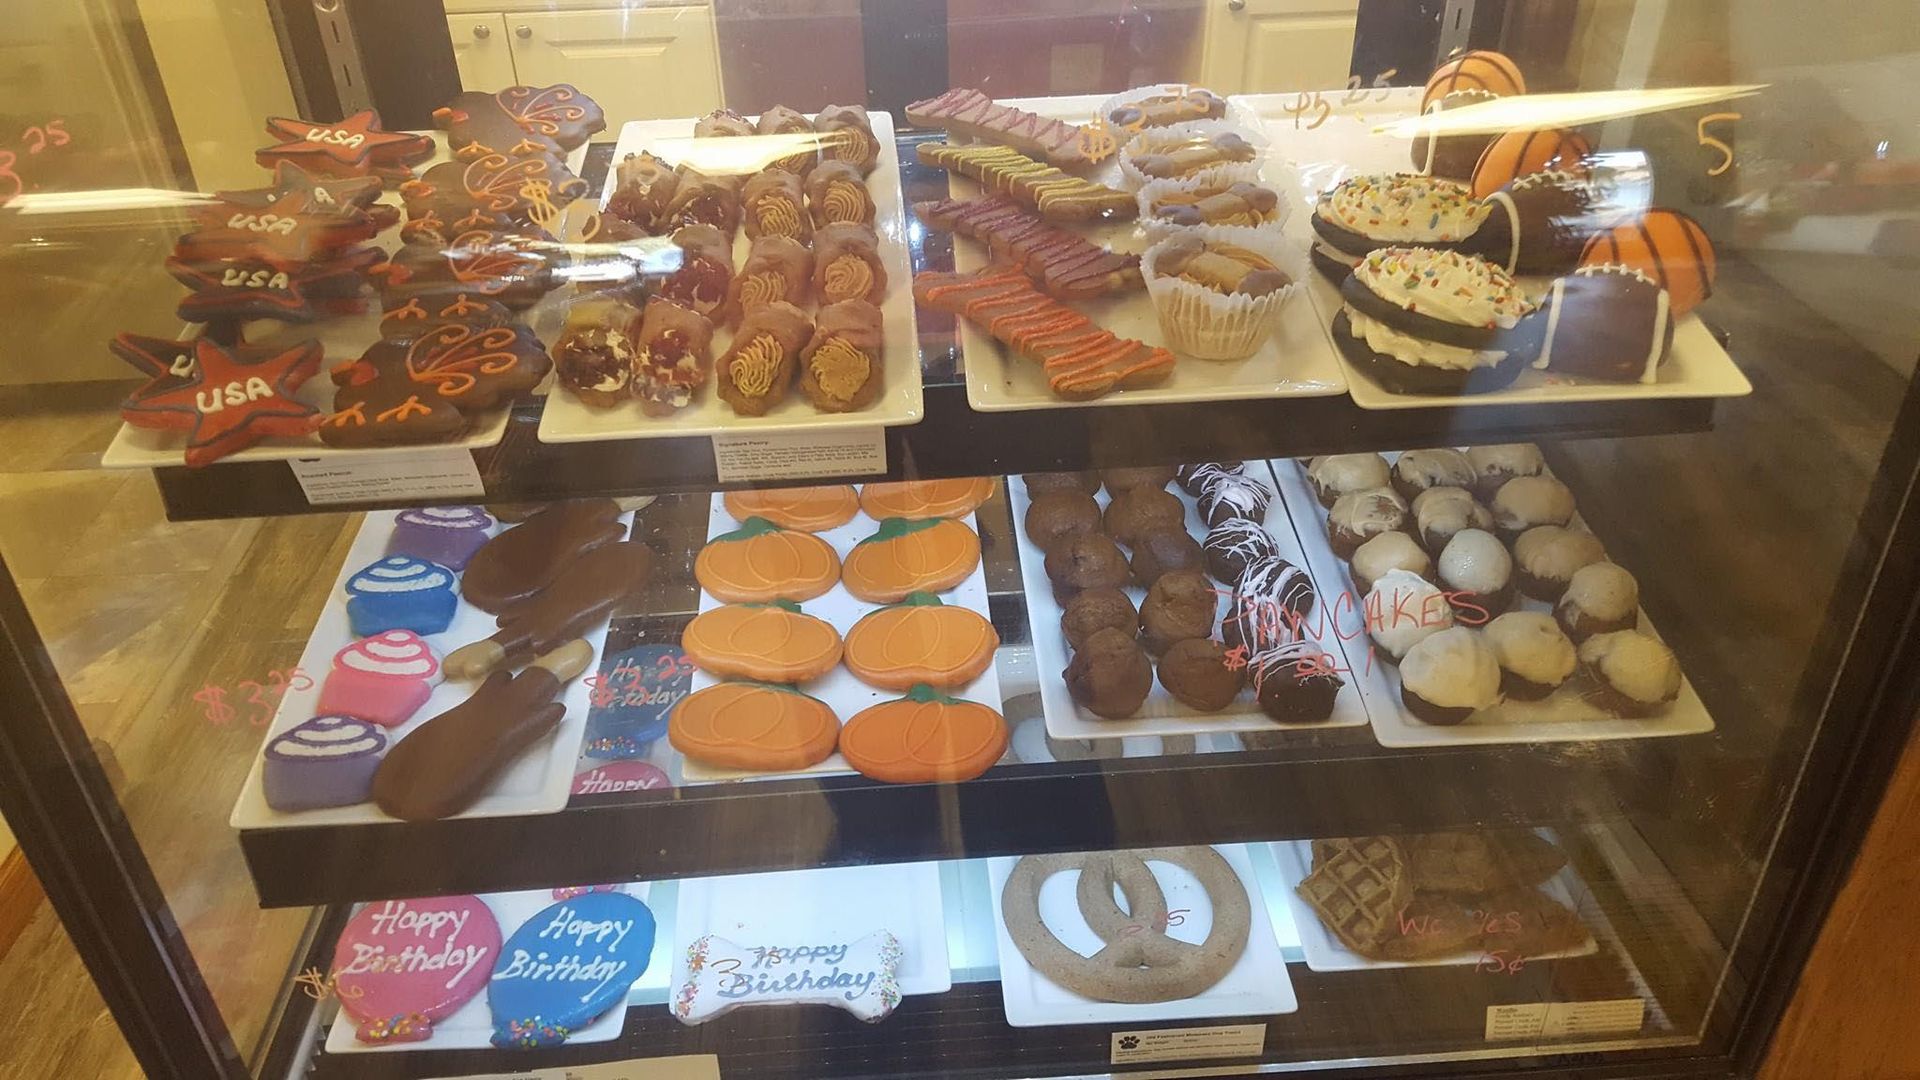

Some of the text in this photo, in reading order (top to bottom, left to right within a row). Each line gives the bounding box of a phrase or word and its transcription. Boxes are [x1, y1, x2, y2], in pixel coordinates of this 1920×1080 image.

[306, 128, 365, 148] USA
[1698, 113, 1741, 175] 5
[227, 213, 297, 235] USA
[221, 268, 289, 289] USA
[196, 377, 274, 413] USA
[371, 900, 470, 942] Happy
[539, 906, 634, 952] Happy
[335, 942, 488, 989] Birthday
[744, 944, 848, 969] Happy
[492, 949, 628, 1003] Birthday
[716, 966, 885, 1000] Birthday
